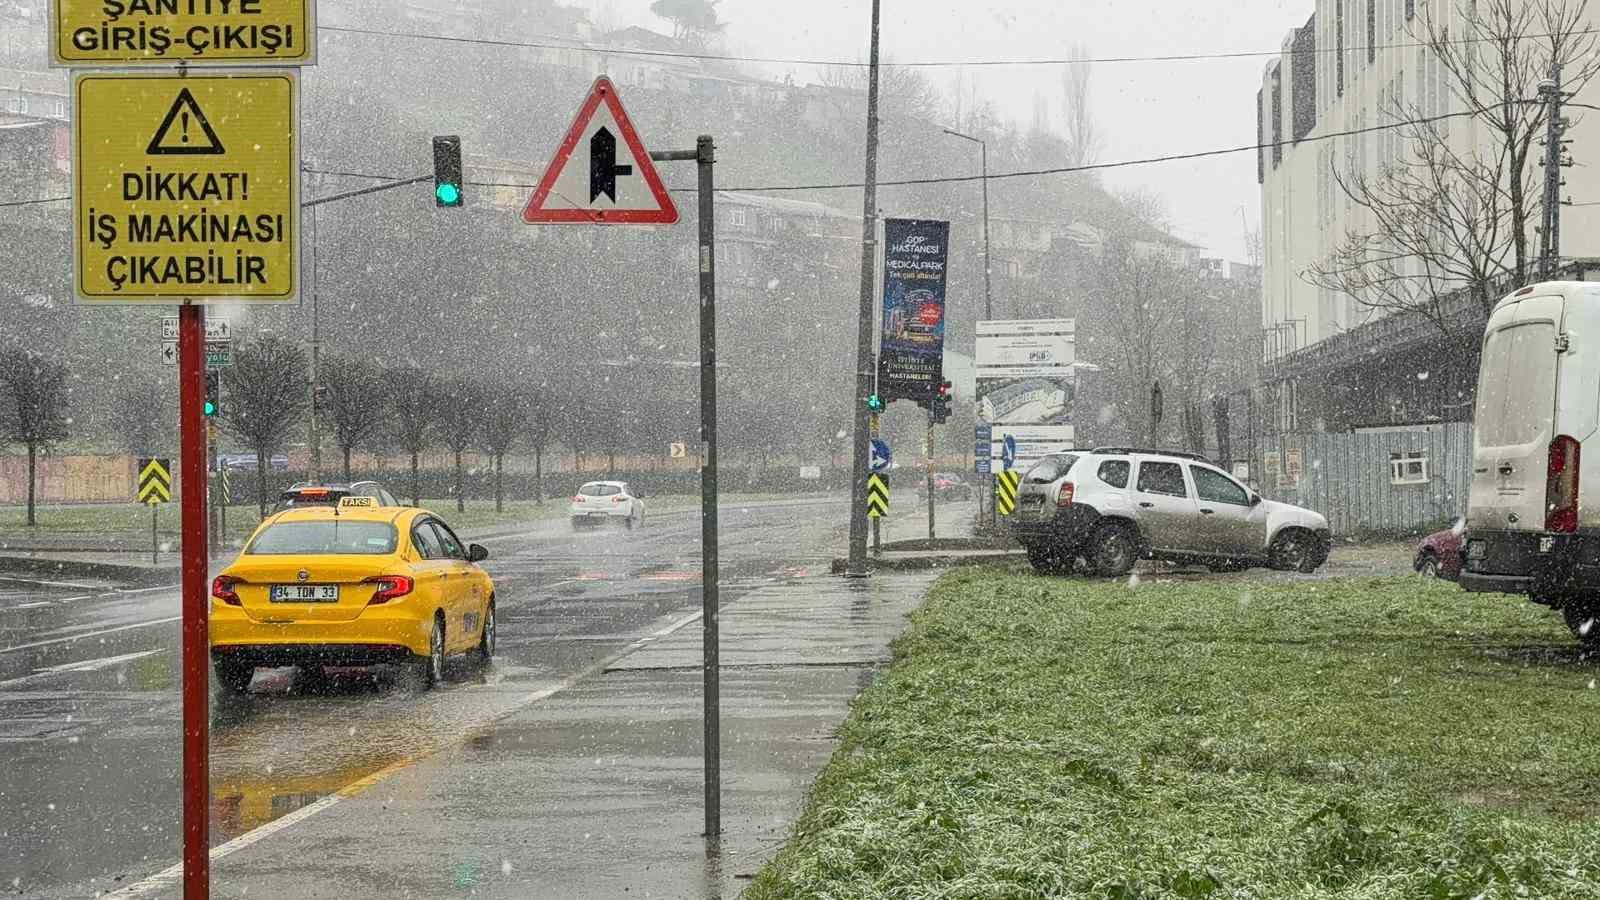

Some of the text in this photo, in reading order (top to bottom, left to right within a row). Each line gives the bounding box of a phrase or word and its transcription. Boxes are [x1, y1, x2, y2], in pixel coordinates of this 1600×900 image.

[72, 21, 293, 55] GİRİŞ-ÇIKIŞI
[122, 165, 249, 201] DİKKAT!
[88, 207, 283, 249] İŞ MAKİNASI
[106, 249, 267, 291] ÇIKABİLİR
[276, 586, 289, 598] 34
